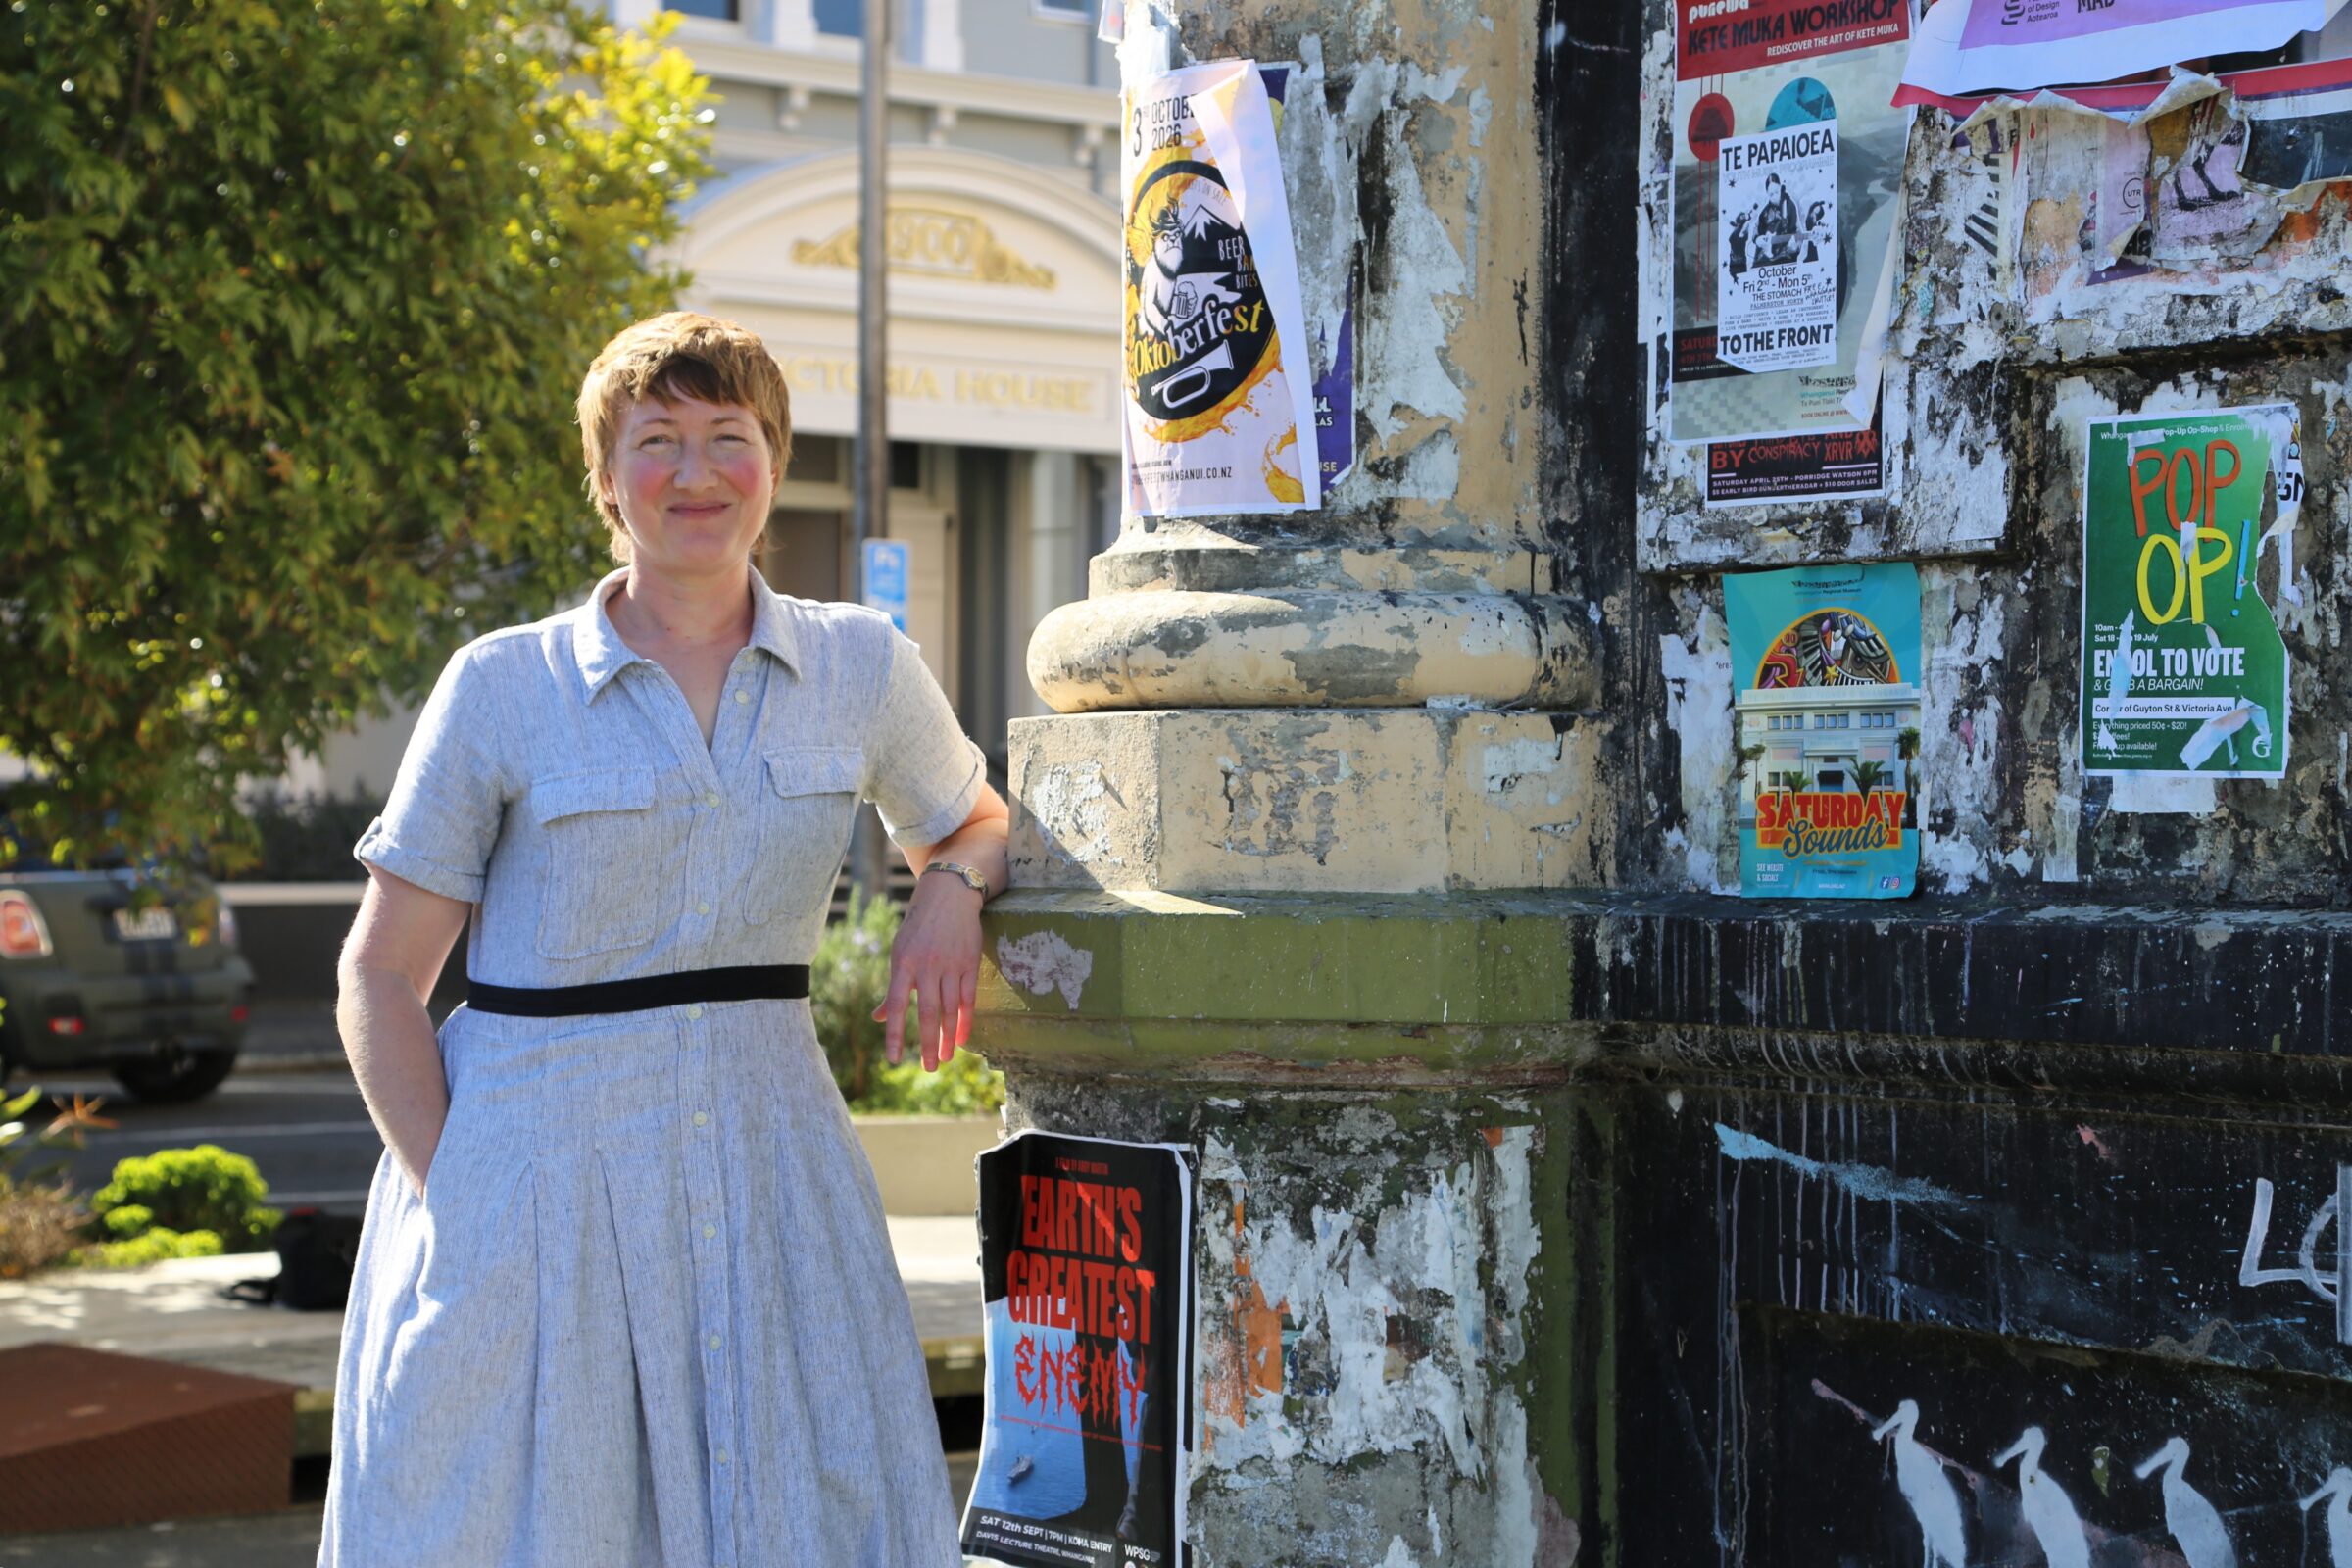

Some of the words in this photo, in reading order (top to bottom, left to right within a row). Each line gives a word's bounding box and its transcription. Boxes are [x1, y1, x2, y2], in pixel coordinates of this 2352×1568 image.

[1689, 24, 1728, 56] KETE
[1732, 13, 1786, 48] MUKA
[1789, 0, 1899, 35] WORKSHOP
[1767, 39, 1813, 57] REDISCOVER
[1814, 36, 1828, 48] THE
[1829, 33, 1843, 45] ART
[1844, 31, 1855, 41] OF
[1856, 27, 1876, 40] KETE
[1876, 23, 1899, 37] MUKA
[1152, 124, 1182, 151] 2026
[1722, 146, 1742, 172] TE
[1747, 128, 1835, 167] PAPAIOEA
[1218, 235, 1246, 261] BEER
[1236, 272, 1258, 289] BITES
[1743, 281, 1755, 294] Fri
[1778, 277, 1799, 289] Mon
[1758, 266, 1797, 279] October
[1752, 293, 1766, 302] THE
[1767, 289, 1802, 301] STOMACH
[1134, 299, 1264, 377] Oktoberfest
[1720, 334, 1742, 355] TO
[1743, 330, 1774, 353] THE
[1778, 324, 1834, 348] FRONT
[955, 366, 1093, 413] HOUSE
[2187, 424, 2219, 436] Op-Shop
[1712, 449, 1744, 469] BY
[1824, 442, 1853, 462] XRVR
[1856, 477, 1878, 486] SALES
[2129, 439, 2241, 542] POP
[2143, 633, 2159, 643] July
[2094, 648, 2157, 677] ENOL
[2161, 648, 2188, 677] TO
[2192, 647, 2245, 676] VOTE
[2094, 679, 2101, 691] &
[2104, 679, 2135, 691] GB
[2137, 679, 2146, 690] A
[2147, 678, 2204, 691] BARGAIN!
[2095, 704, 2124, 712] Corr
[2125, 704, 2132, 712] of
[2133, 705, 2163, 714] Guyton
[2164, 704, 2173, 712] St
[2182, 704, 2215, 712] Victoria
[2216, 704, 2232, 712] Ave
[2093, 721, 2130, 731] Evrything
[2130, 721, 2151, 731] priced
[2171, 721, 2187, 730] $20!
[2126, 742, 2157, 751] available!
[1756, 792, 1907, 829] SATURDAY
[1783, 816, 1888, 858] Sounds
[1020, 1175, 1142, 1263] EARTH'S
[1006, 1250, 1155, 1345] GREATEST
[1014, 1329, 1146, 1435] ENEMY
[976, 1530, 999, 1542] DAVIS
[1000, 1536, 1032, 1550] LECTURE
[980, 1515, 998, 1527] SAT
[1002, 1519, 1022, 1533] 12th
[1023, 1525, 1043, 1538] SEPT
[1049, 1530, 1063, 1543] 7PM
[1067, 1535, 1089, 1548] KOHA
[1090, 1540, 1113, 1553] ENTRY
[1124, 1544, 1151, 1561] WPSG
